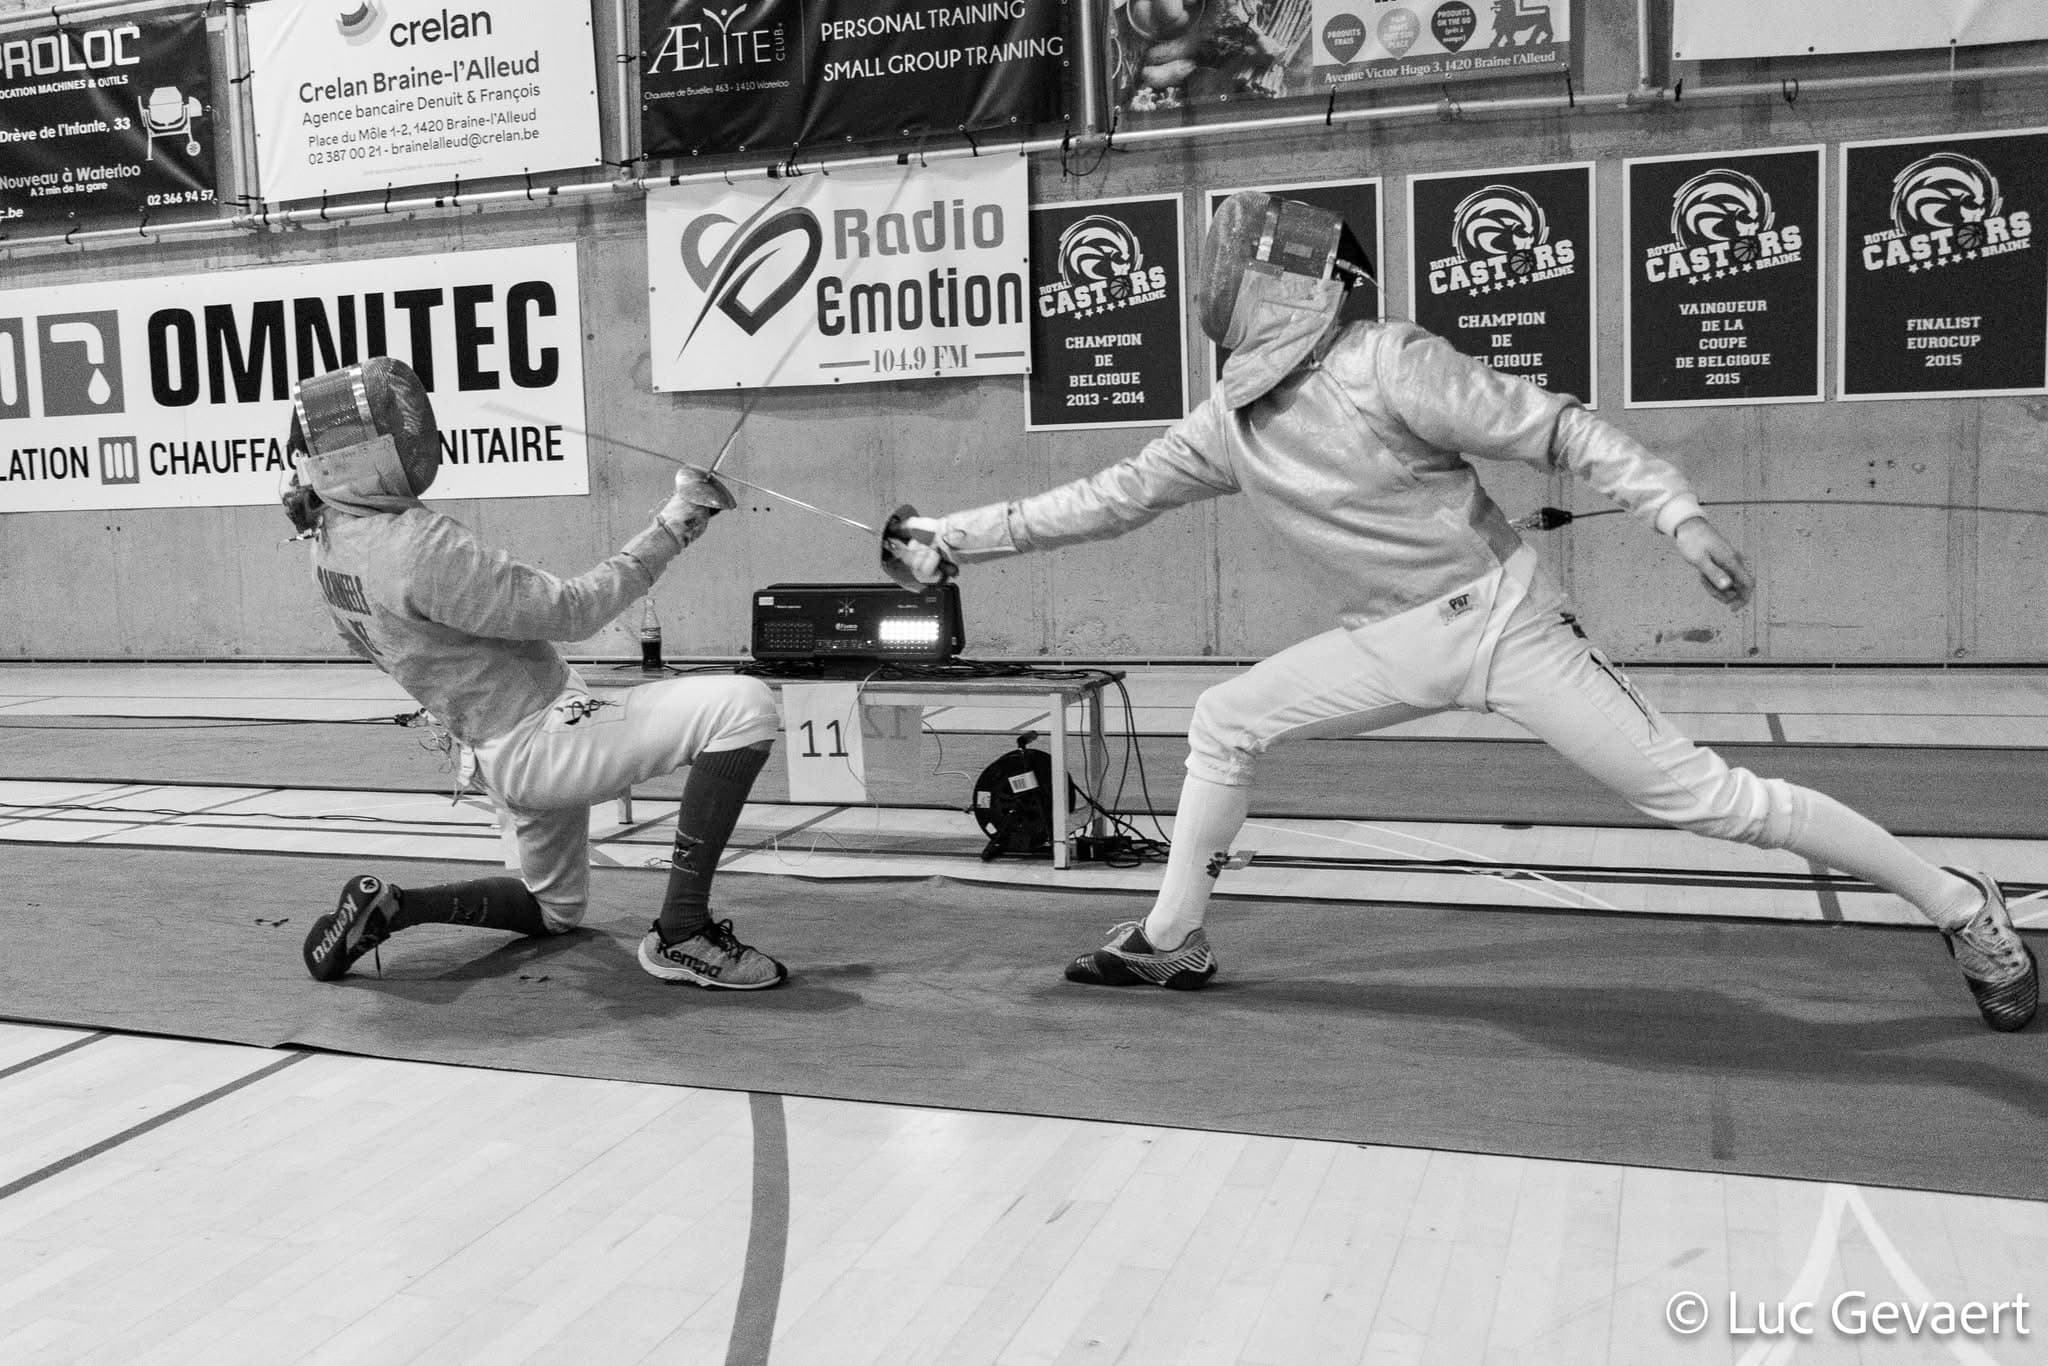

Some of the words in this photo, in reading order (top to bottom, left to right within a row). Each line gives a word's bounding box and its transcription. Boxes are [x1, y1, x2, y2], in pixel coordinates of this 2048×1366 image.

[389, 8, 493, 48] crelan
[820, 11, 926, 42] PERSONAL
[928, 0, 1026, 28] TRAINING
[0, 26, 140, 79] ROLOC
[823, 57, 885, 82] SMALL
[888, 49, 962, 74] GROUP
[965, 36, 1064, 66] TRAINING
[1324, 72, 1364, 83] Avenue
[1365, 65, 1400, 79] Victor
[1400, 63, 1431, 77] Hugo
[1445, 58, 1472, 71] 1420
[1474, 54, 1512, 69] Braine
[1513, 51, 1556, 66] l'Alleud
[38, 79, 86, 94] MACHINES
[88, 79, 96, 89] &
[98, 75, 129, 88] OUTILS
[299, 76, 368, 103] Crelan
[373, 50, 540, 94] Braine-l'Alleud
[302, 106, 353, 128] Agence
[355, 98, 414, 119] bancaire
[417, 91, 464, 111] Denuit
[466, 90, 477, 105] &
[480, 82, 541, 103] François
[0, 128, 37, 143] Drève
[40, 126, 56, 139] de
[58, 120, 110, 137] l'Infante,
[113, 117, 131, 130] 33
[308, 134, 339, 148] Place
[341, 131, 357, 144] du
[359, 127, 388, 141] Môle
[413, 119, 444, 134] 1420
[446, 108, 537, 131] Braine-l'Alleud
[308, 153, 324, 166] 02
[326, 149, 346, 164] 387
[350, 148, 366, 161] 00
[368, 144, 383, 159] 21
[391, 127, 541, 155] brainelalleud@crelan.be
[0, 173, 58, 190] Nouveau
[62, 167, 73, 183] à
[76, 163, 141, 181] Waterloo
[30, 187, 38, 197] A
[38, 186, 45, 197] 2
[45, 184, 61, 196] min
[62, 184, 74, 194] de
[75, 182, 85, 192] la
[86, 181, 108, 193] gare
[147, 194, 161, 206] 02
[163, 192, 183, 205] 366
[184, 190, 198, 202] 94
[834, 199, 1004, 260] Radio
[1864, 229, 1907, 245] ROYAL
[1646, 242, 1687, 258] ROYAL
[1981, 238, 2031, 257] BRAINE
[1429, 255, 1467, 271] ROYAL
[1755, 251, 1802, 270] BRAINE
[1531, 264, 1575, 282] BRAINE
[1039, 280, 1072, 295] ROYAL
[816, 267, 1023, 336] Emotion
[1128, 289, 1167, 306] BRAINE
[1679, 300, 1767, 315] VAINQUEUR
[1458, 312, 1546, 328] CHAMPION
[1701, 320, 1720, 332] DE
[1724, 319, 1744, 331] LA
[1907, 316, 1982, 331] FINALIST
[147, 280, 560, 407] OMNITEC
[1065, 333, 1142, 349] CHAMPION
[1491, 334, 1512, 347] DE
[1699, 337, 1747, 350] COUPE
[1907, 335, 1981, 349] EUROCUP
[872, 346, 926, 373] 104.9
[932, 344, 968, 369] FM
[1094, 354, 1113, 367] DE
[1472, 353, 1543, 368] LGIQUE
[1675, 356, 1694, 369] DE
[1698, 353, 1771, 368] BELGIQUE
[1925, 354, 1962, 367] 2015
[1069, 372, 1140, 387] BELGIQUE
[1705, 373, 1740, 385] 2015
[1066, 393, 1100, 407] 2013
[1112, 391, 1145, 405] 2014
[0, 446, 90, 481] ATION
[800, 719, 849, 758] 11
